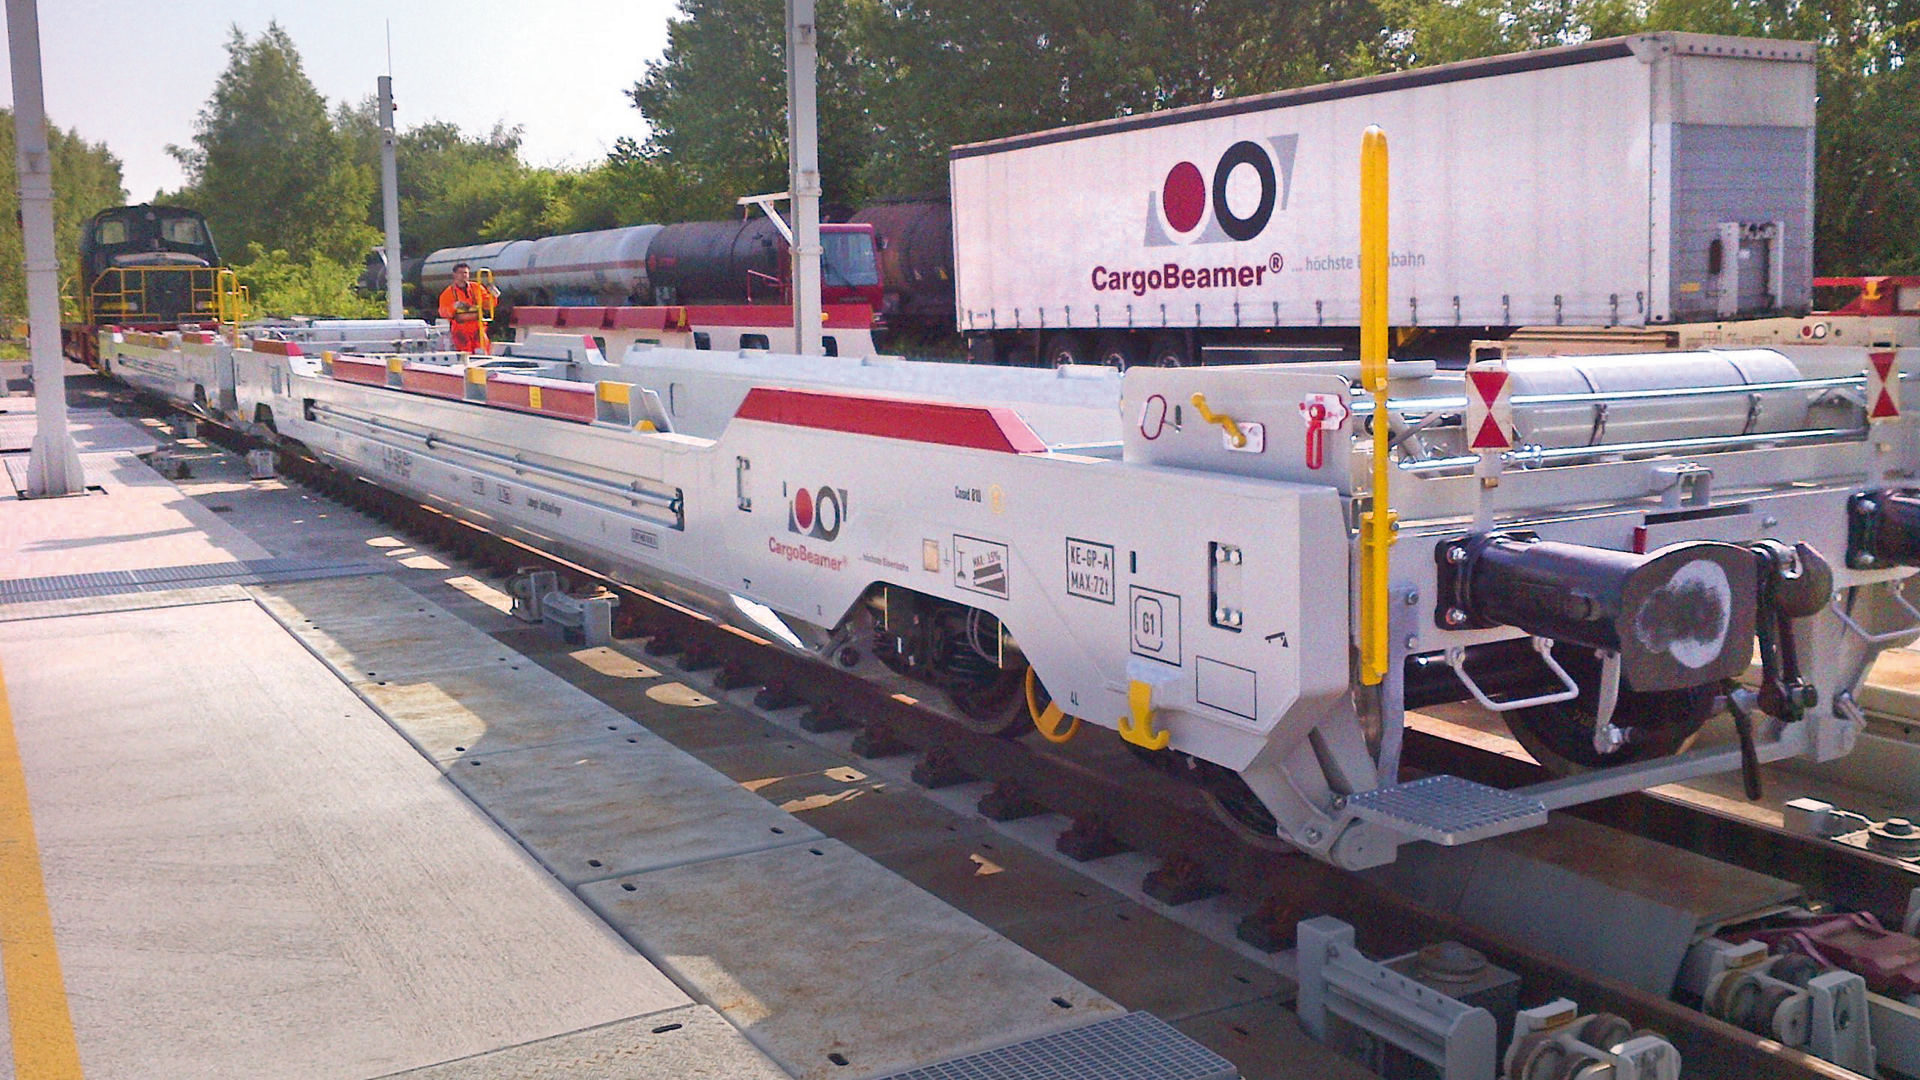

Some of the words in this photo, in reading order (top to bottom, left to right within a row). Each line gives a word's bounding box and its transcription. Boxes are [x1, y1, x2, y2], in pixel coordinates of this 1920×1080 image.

[1305, 254, 1353, 271] höchste
[1070, 546, 1110, 571] KE-GP-A
[1142, 612, 1155, 636] G1
